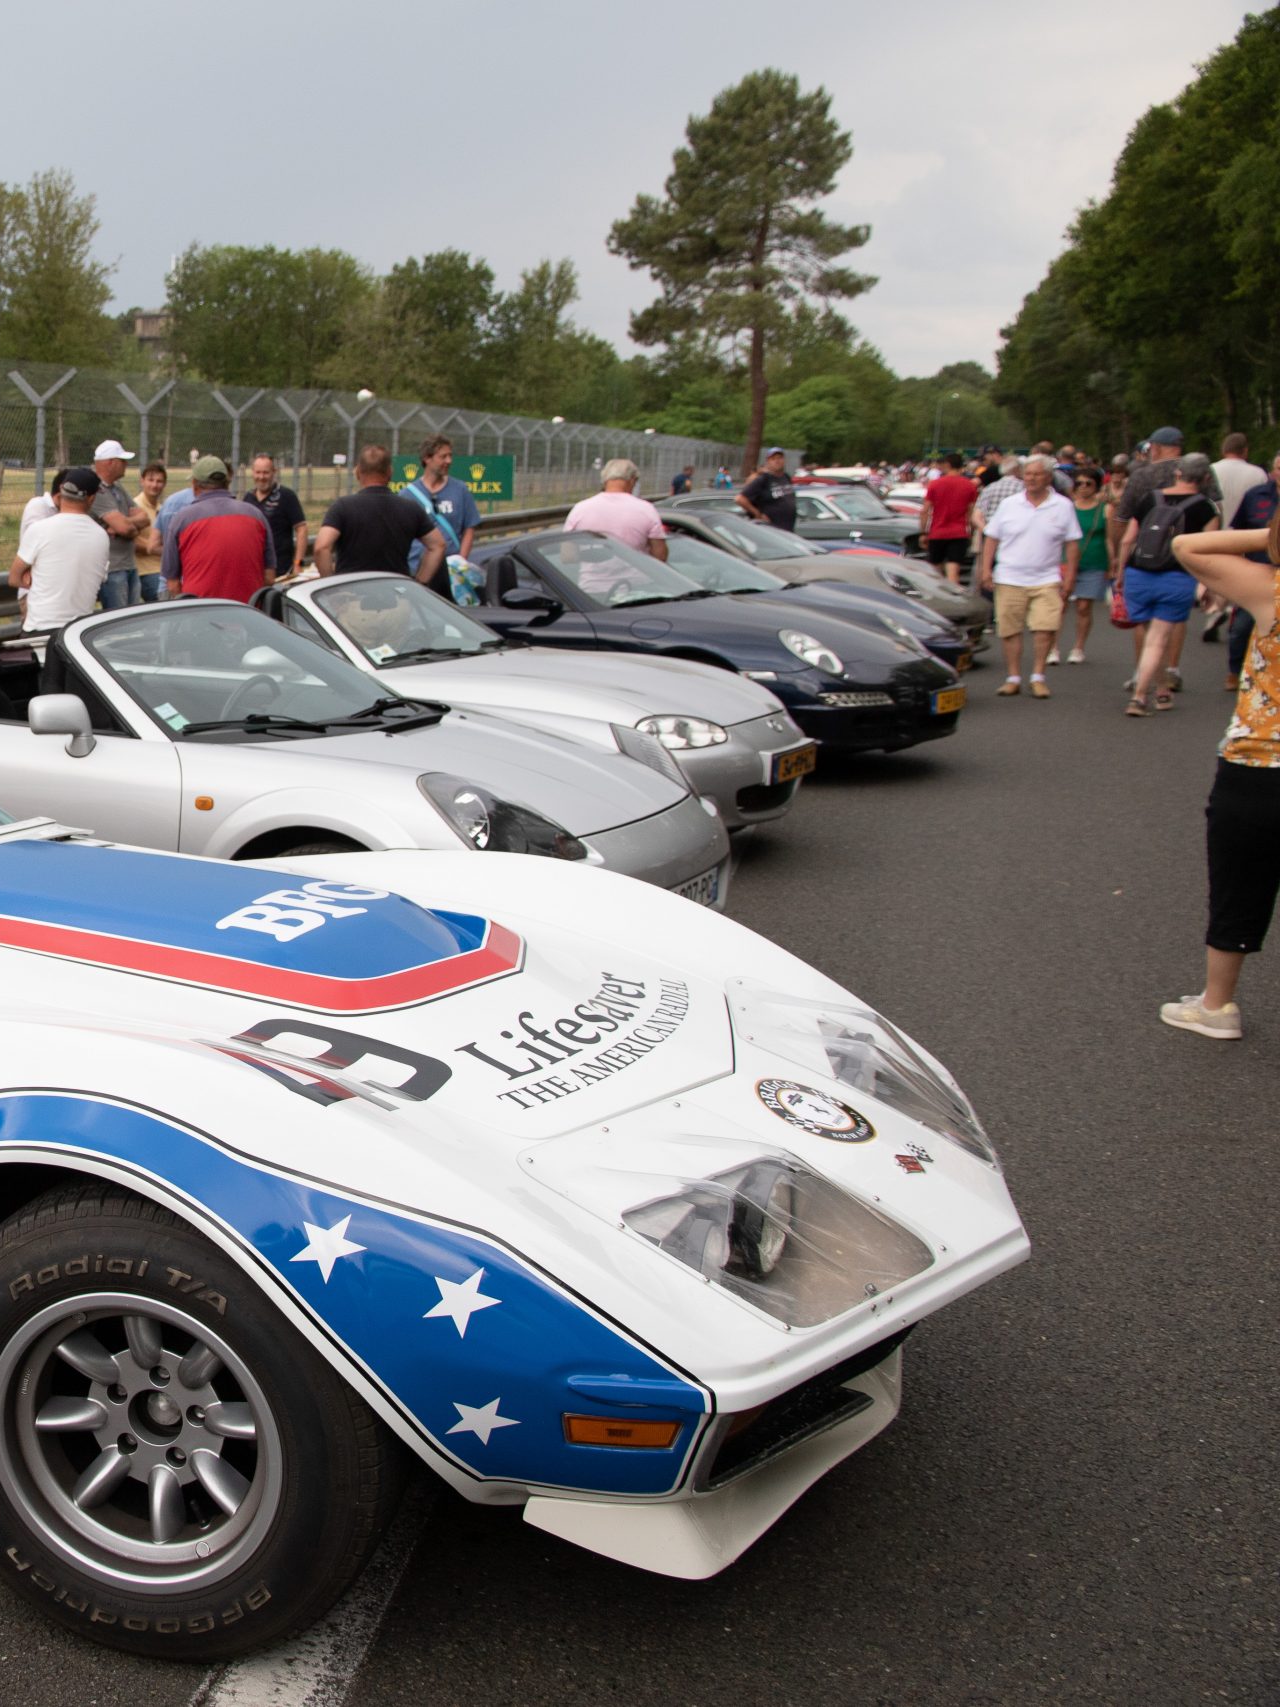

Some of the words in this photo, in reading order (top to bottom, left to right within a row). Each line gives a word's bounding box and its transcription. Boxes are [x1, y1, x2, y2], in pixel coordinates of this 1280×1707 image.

[215, 880, 390, 943] BFG
[454, 971, 647, 1082] Lifesaver
[496, 1075, 581, 1111] THE
[569, 1012, 679, 1087] AMERICAN
[654, 978, 690, 1023] RADIAL
[759, 1079, 801, 1110] BRIGGS
[8, 1254, 149, 1301] Radial
[166, 1266, 230, 1317] T/A
[6, 1546, 273, 1635] BFGoodrich
